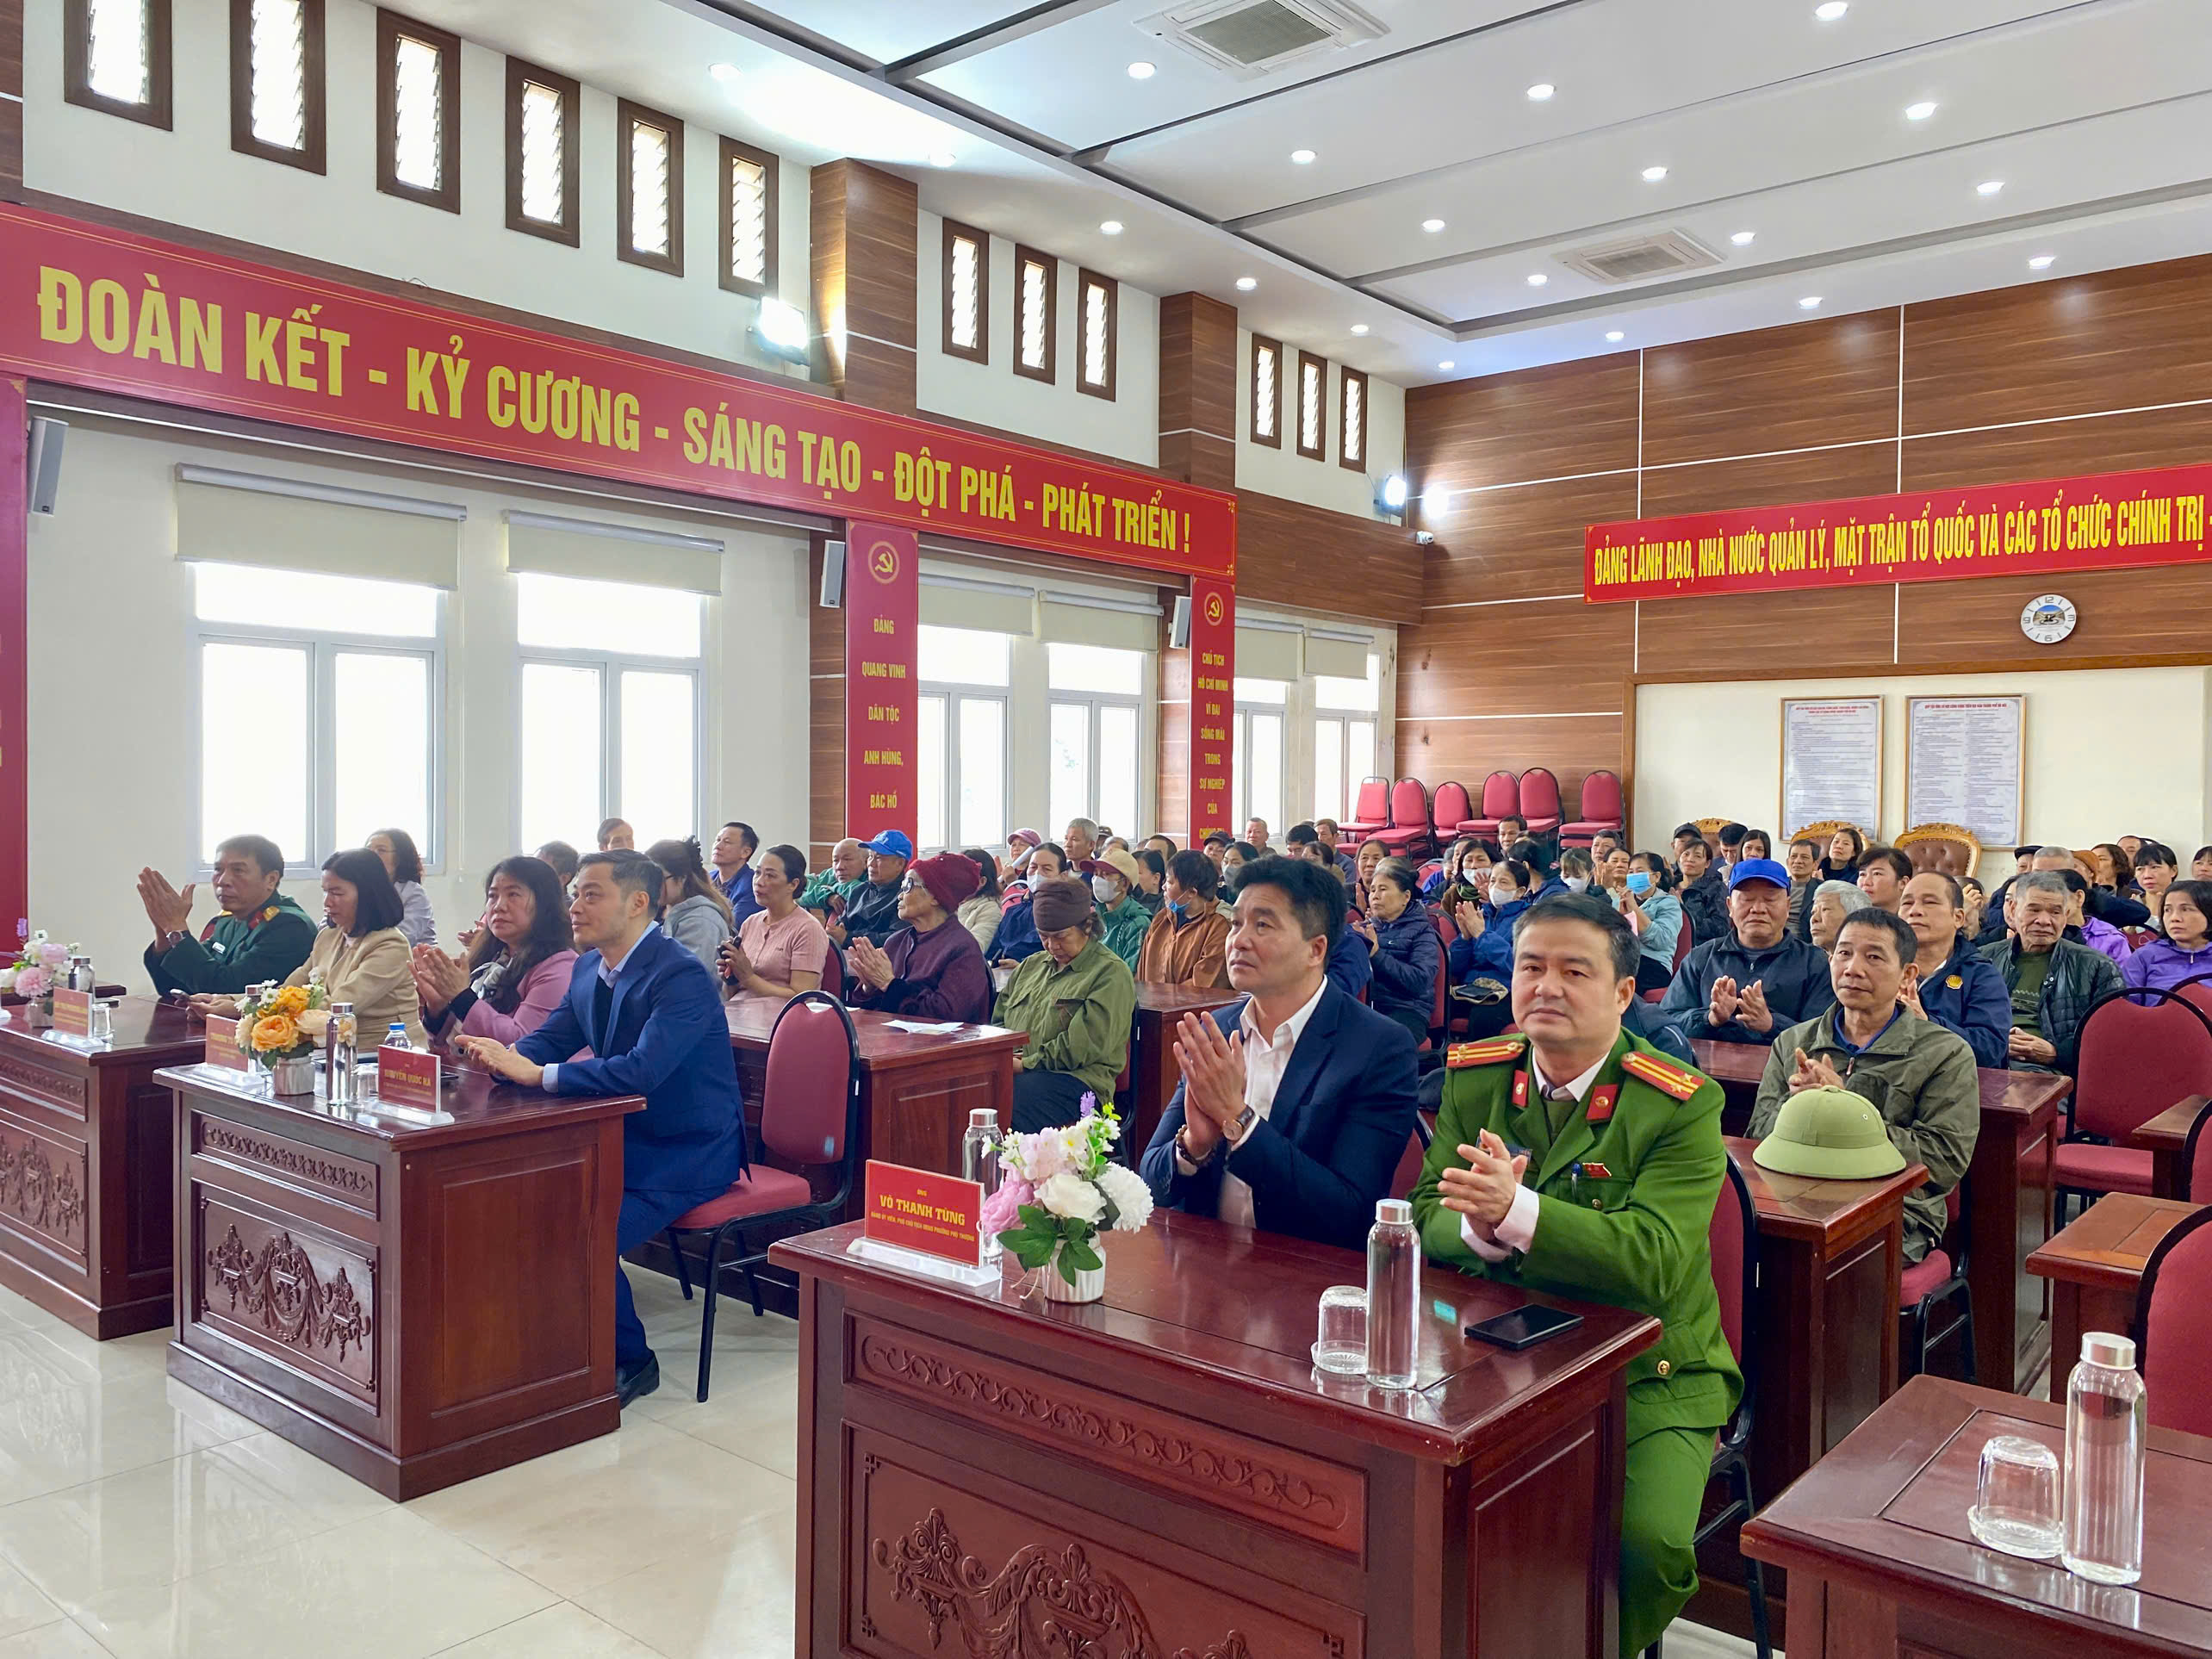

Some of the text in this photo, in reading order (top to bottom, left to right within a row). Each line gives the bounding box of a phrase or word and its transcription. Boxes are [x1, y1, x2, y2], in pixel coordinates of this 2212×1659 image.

[37, 265, 223, 375] ĐOÀN
[245, 303, 351, 397] KẾT
[406, 334, 470, 419] KỶ
[486, 364, 641, 452] CƯƠNG
[683, 402, 786, 480] SÁNG
[797, 430, 861, 500] TẠO
[893, 446, 952, 517] ĐỘT
[960, 464, 1016, 522] PHÁ
[1042, 482, 1106, 537] PHÁT
[1111, 488, 1177, 552] TRIỂN
[1594, 535, 1627, 585] ĐẢNG
[1631, 537, 1662, 582] LÃNH
[1666, 540, 1694, 587] ĐẠO,
[1699, 529, 1724, 577] NHÀ
[1729, 526, 1764, 575] NƯỚC
[1769, 518, 1805, 576] QUẢN
[1810, 519, 1830, 573] LÝ,
[1834, 517, 1865, 575] MẶT
[1869, 513, 1907, 572] TRẬN
[1911, 502, 1930, 561] TỔ
[1934, 500, 1974, 564] QUỐC
[1979, 504, 1998, 556] VÀ
[2004, 501, 2036, 555] CÁC
[2041, 489, 2062, 551] TỔ
[2066, 494, 2111, 550] CHỨC
[2117, 490, 2171, 546] CHÍNH
[2177, 495, 2204, 550] TRỊ
[873, 614, 894, 635] ĐẢNG
[861, 661, 906, 679] QUANG VINH
[868, 704, 900, 724] DÂN TỘC
[864, 750, 879, 766] ANH
[1205, 753, 1221, 765] TRONG
[870, 790, 898, 809] BÁC HỒ
[896, 1198, 933, 1218] THANH
[935, 1208, 965, 1226] TÙNG
